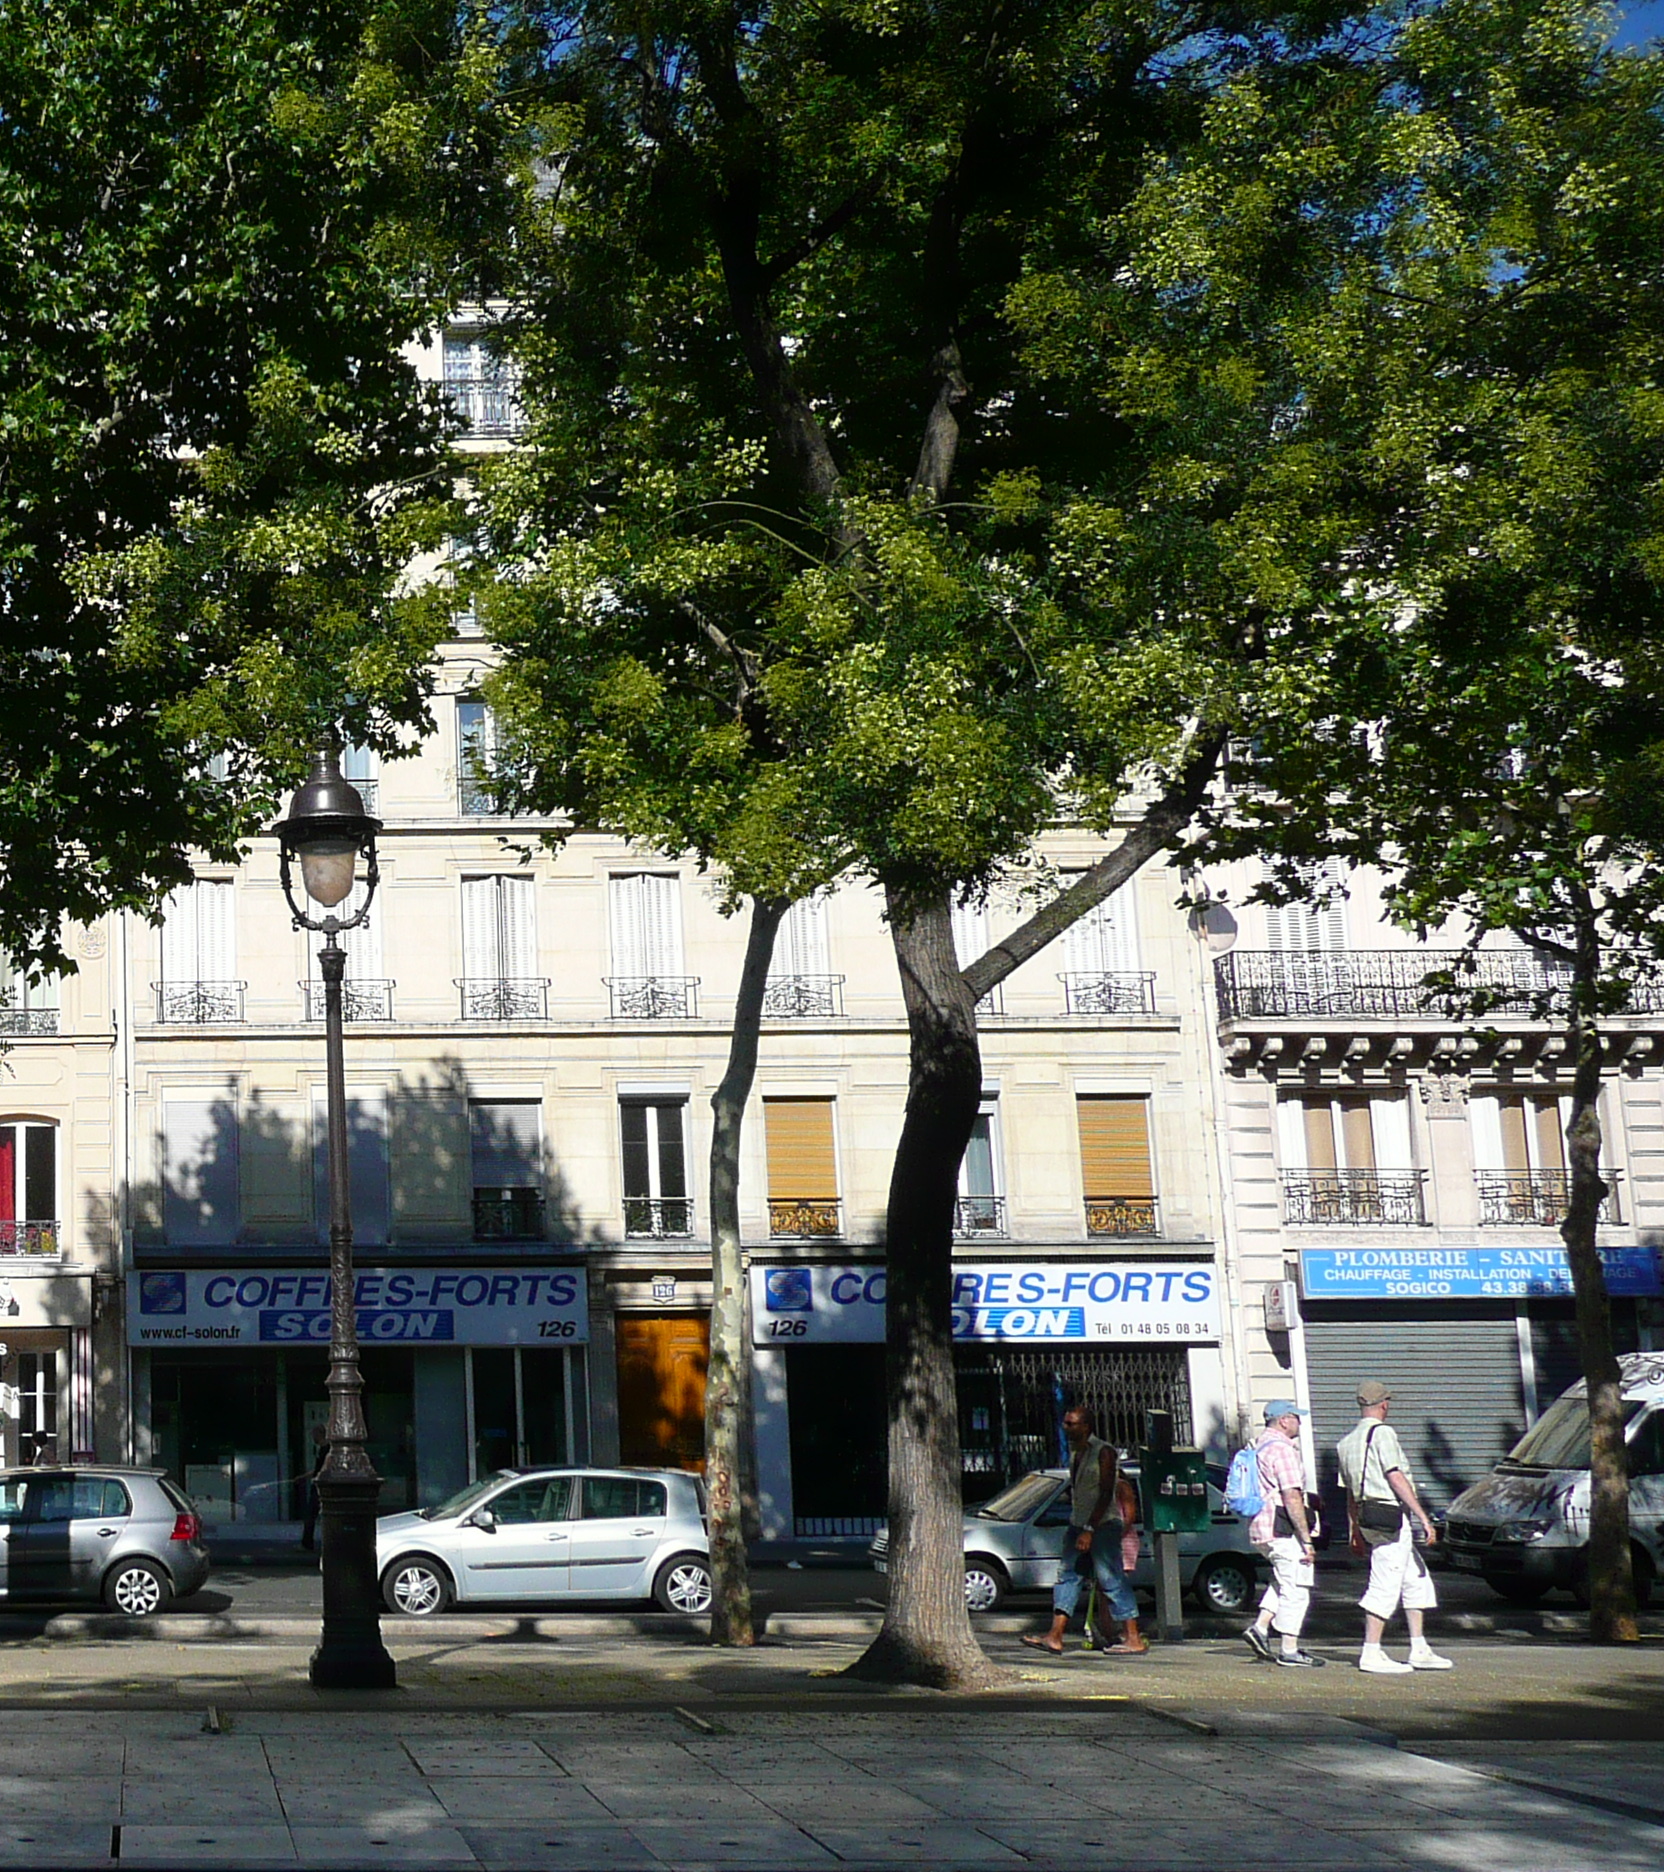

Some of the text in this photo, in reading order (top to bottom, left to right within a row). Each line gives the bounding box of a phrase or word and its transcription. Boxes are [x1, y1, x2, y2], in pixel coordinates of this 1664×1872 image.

[1334, 1250, 1624, 1266] PLOMBERIE SANITRE
[1324, 1269, 1412, 1281] CHAUFFAGE
[1429, 1268, 1532, 1280] INSTALLATION
[831, 1272, 1212, 1305] CORES-FORTS
[1386, 1282, 1451, 1294] SOGICO
[537, 1321, 576, 1338] 126
[768, 1320, 808, 1337] 126
[952, 1309, 1071, 1336] OLON
[1095, 1322, 1209, 1335] Tél 01 48 05 08 34
